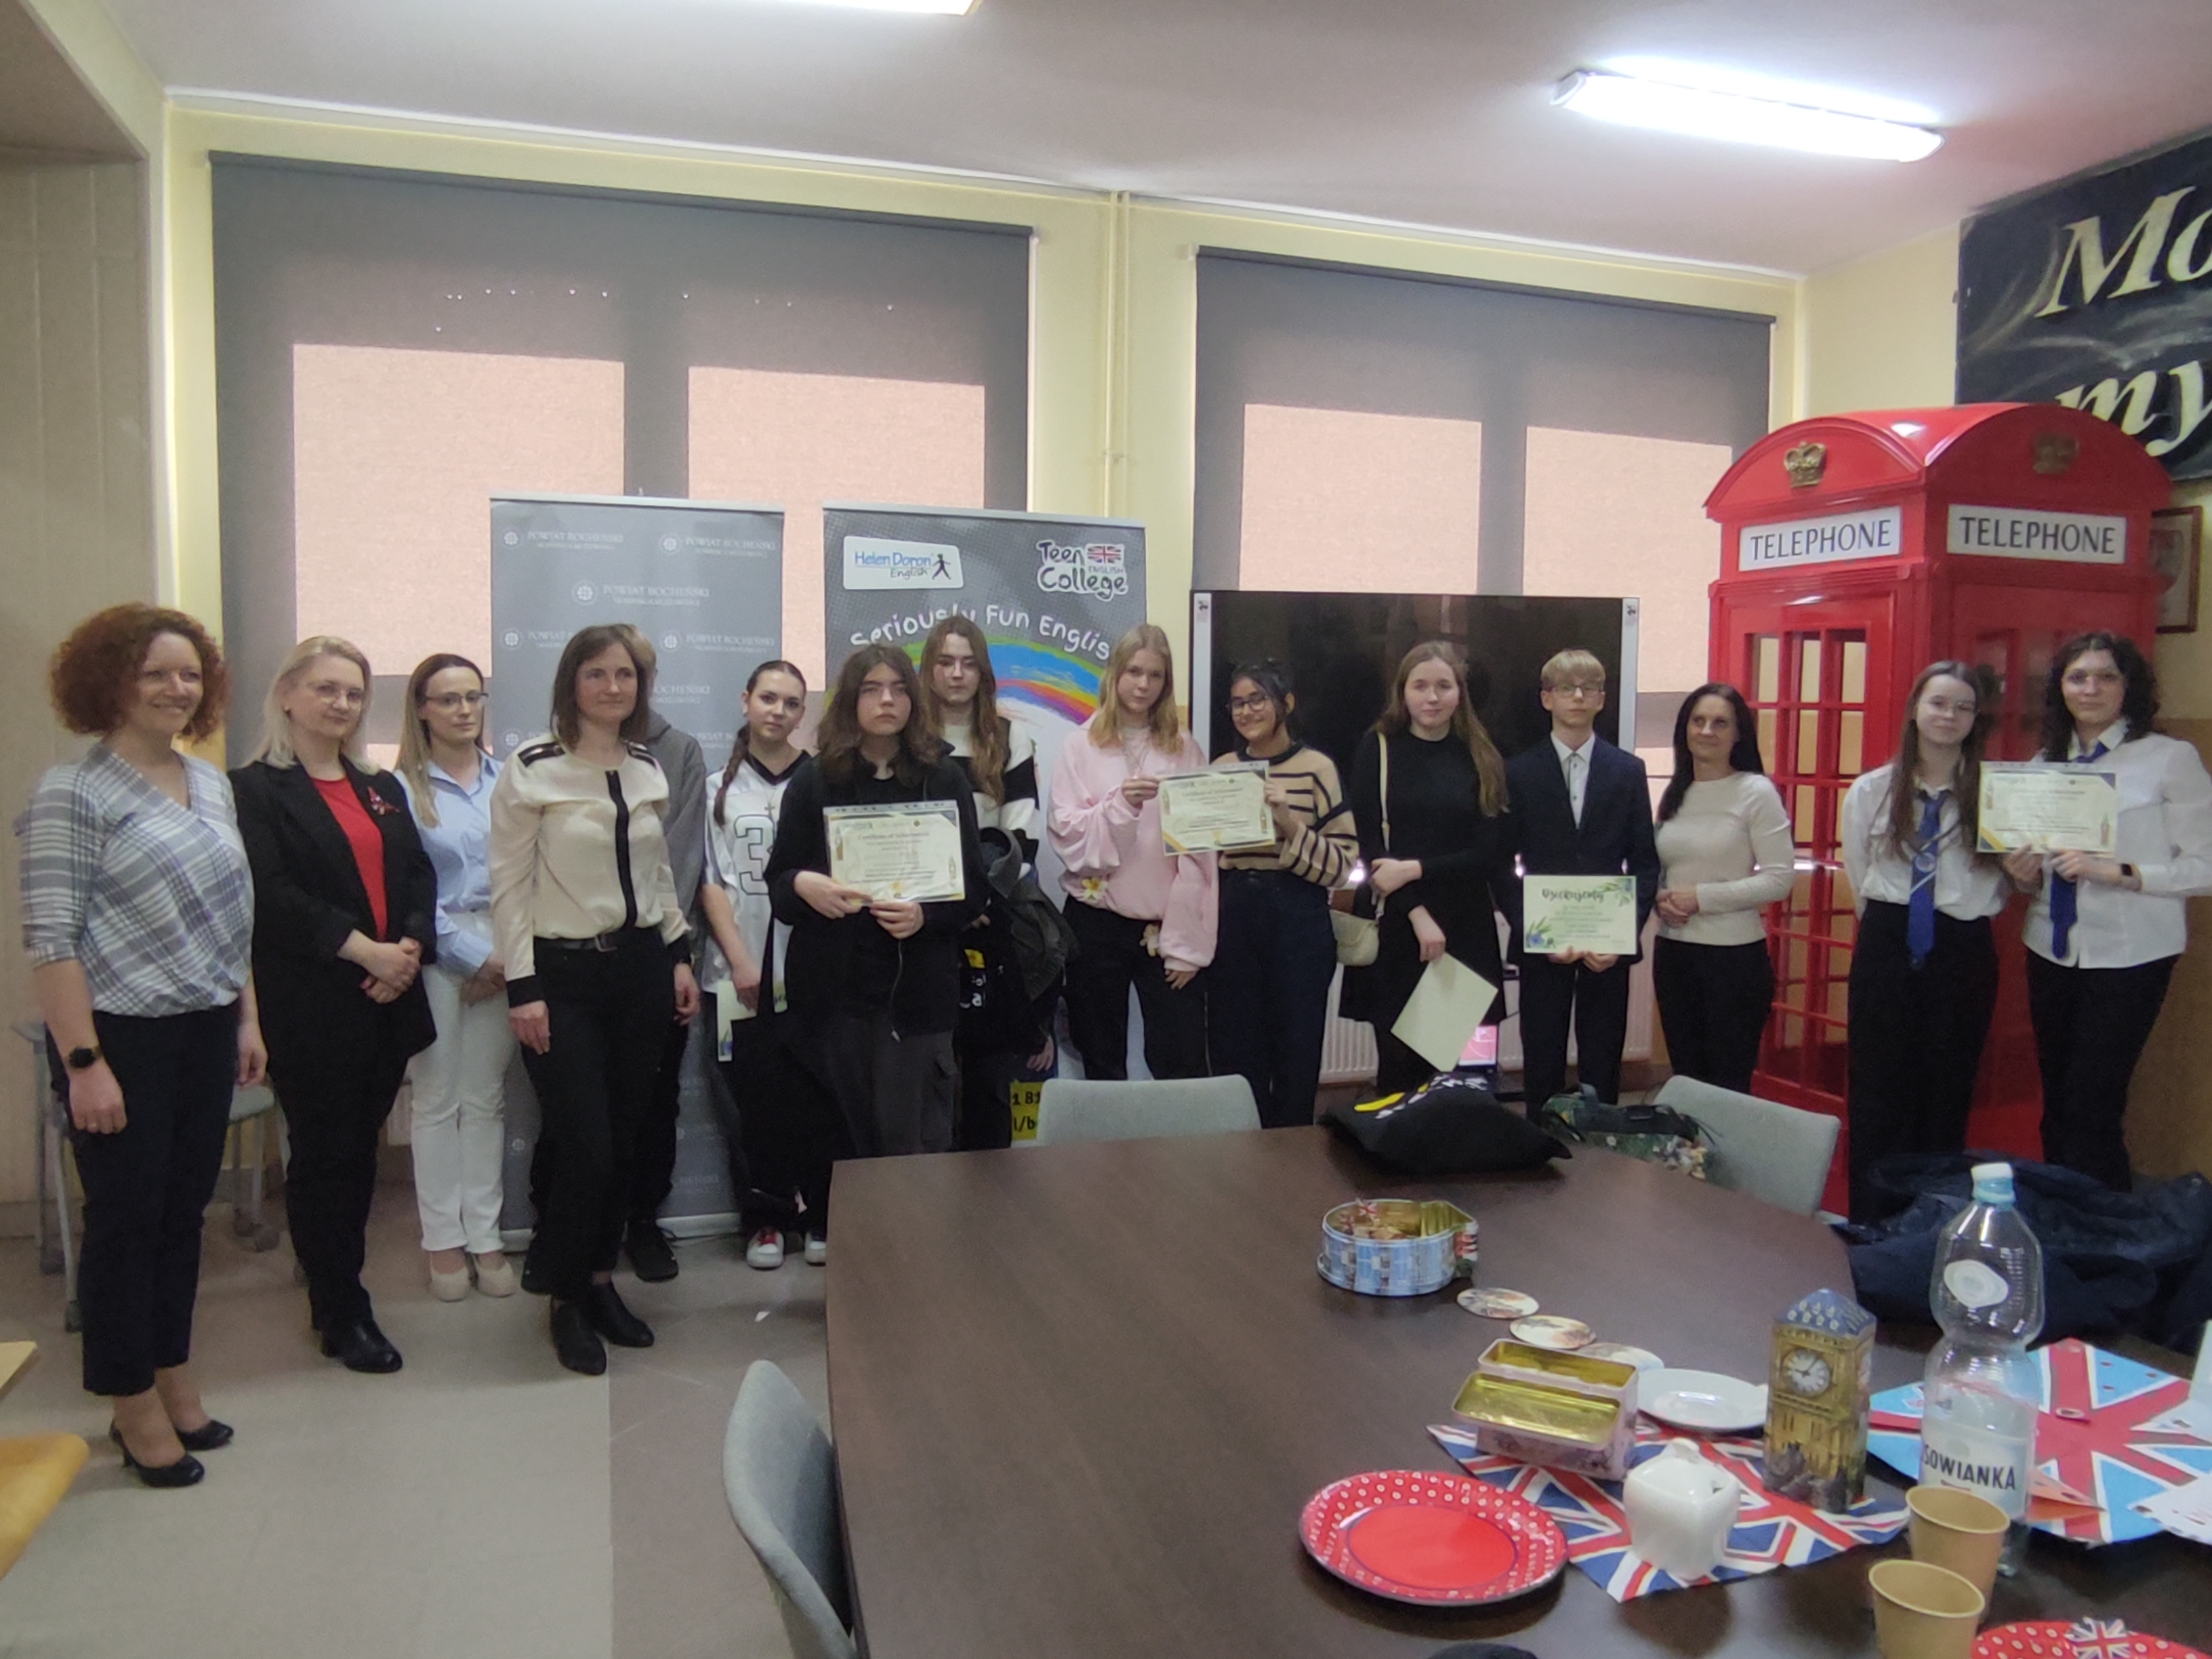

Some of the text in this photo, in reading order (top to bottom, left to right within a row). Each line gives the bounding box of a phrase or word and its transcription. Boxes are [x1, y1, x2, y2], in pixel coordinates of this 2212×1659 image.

[1750, 519, 1891, 561] TELEPHONE
[1959, 516, 2116, 554] TELEPHONE
[855, 551, 931, 567] Helen Doron
[1038, 541, 1085, 565] Teen
[890, 567, 928, 580] English
[1040, 567, 1126, 600] College
[986, 605, 1029, 629] Fun
[1039, 615, 1110, 660] Englis
[734, 815, 775, 895] 3
